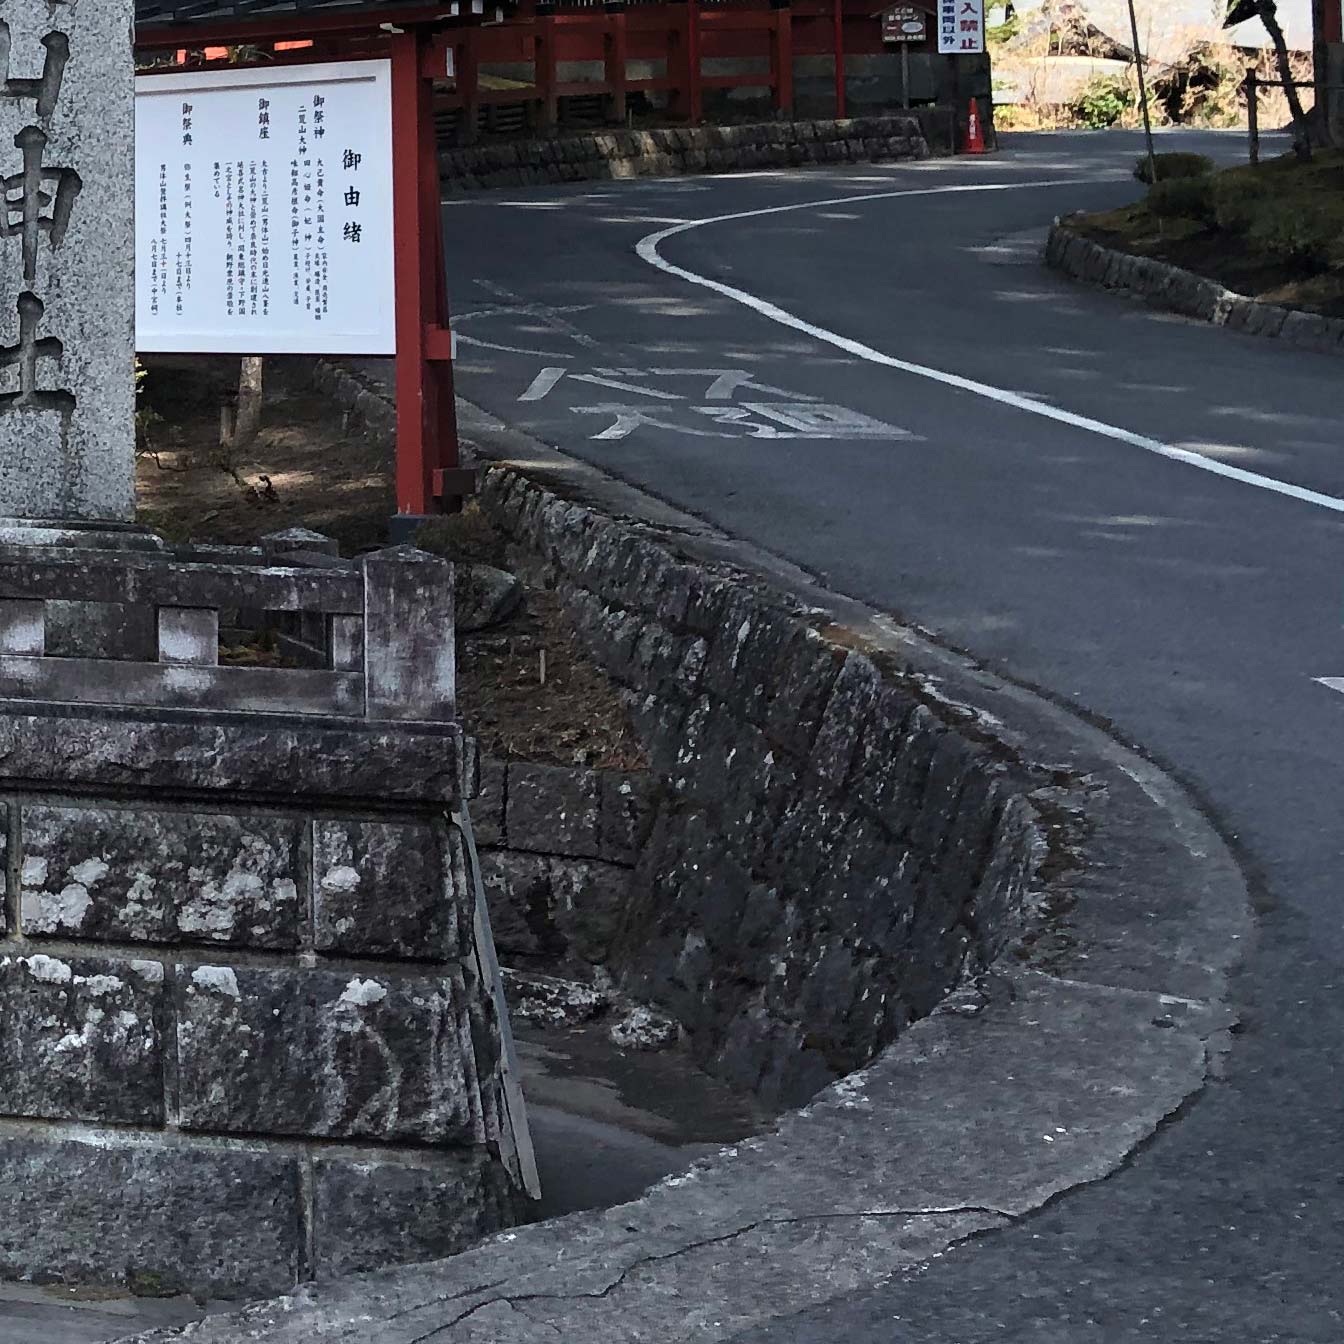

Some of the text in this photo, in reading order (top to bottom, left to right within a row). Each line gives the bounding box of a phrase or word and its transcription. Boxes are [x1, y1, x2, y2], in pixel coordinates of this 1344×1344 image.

[313, 95, 325, 139] 御祭神
[342, 149, 362, 243] 御由緒
